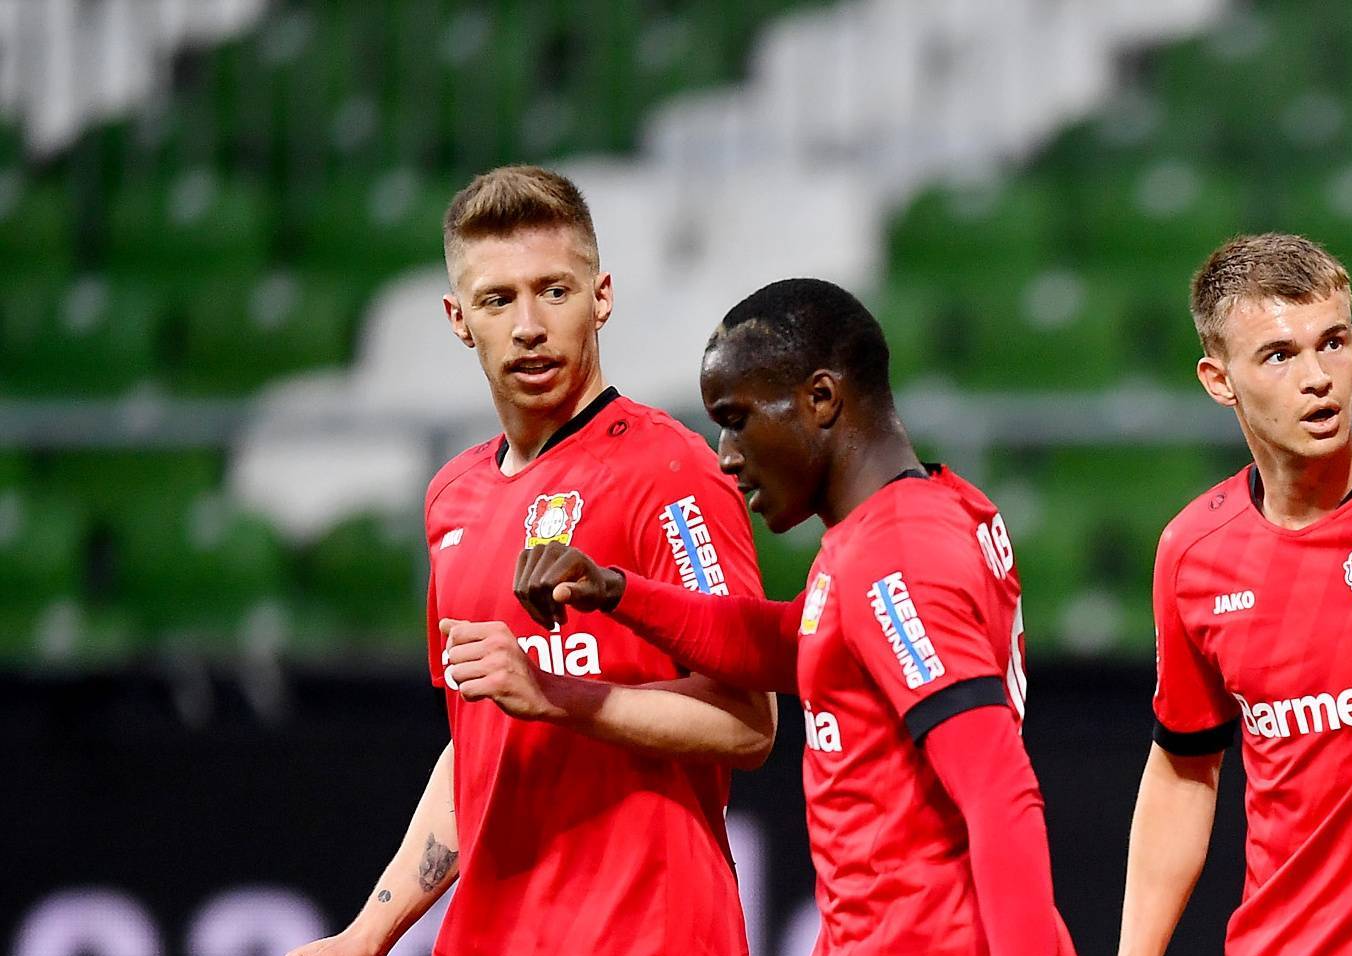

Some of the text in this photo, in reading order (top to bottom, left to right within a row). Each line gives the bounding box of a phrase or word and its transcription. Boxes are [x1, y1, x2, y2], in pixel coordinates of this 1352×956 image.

[866, 581, 924, 690] TRAINING
[883, 571, 946, 681] KIESER
[1212, 590, 1255, 615] JAKO
